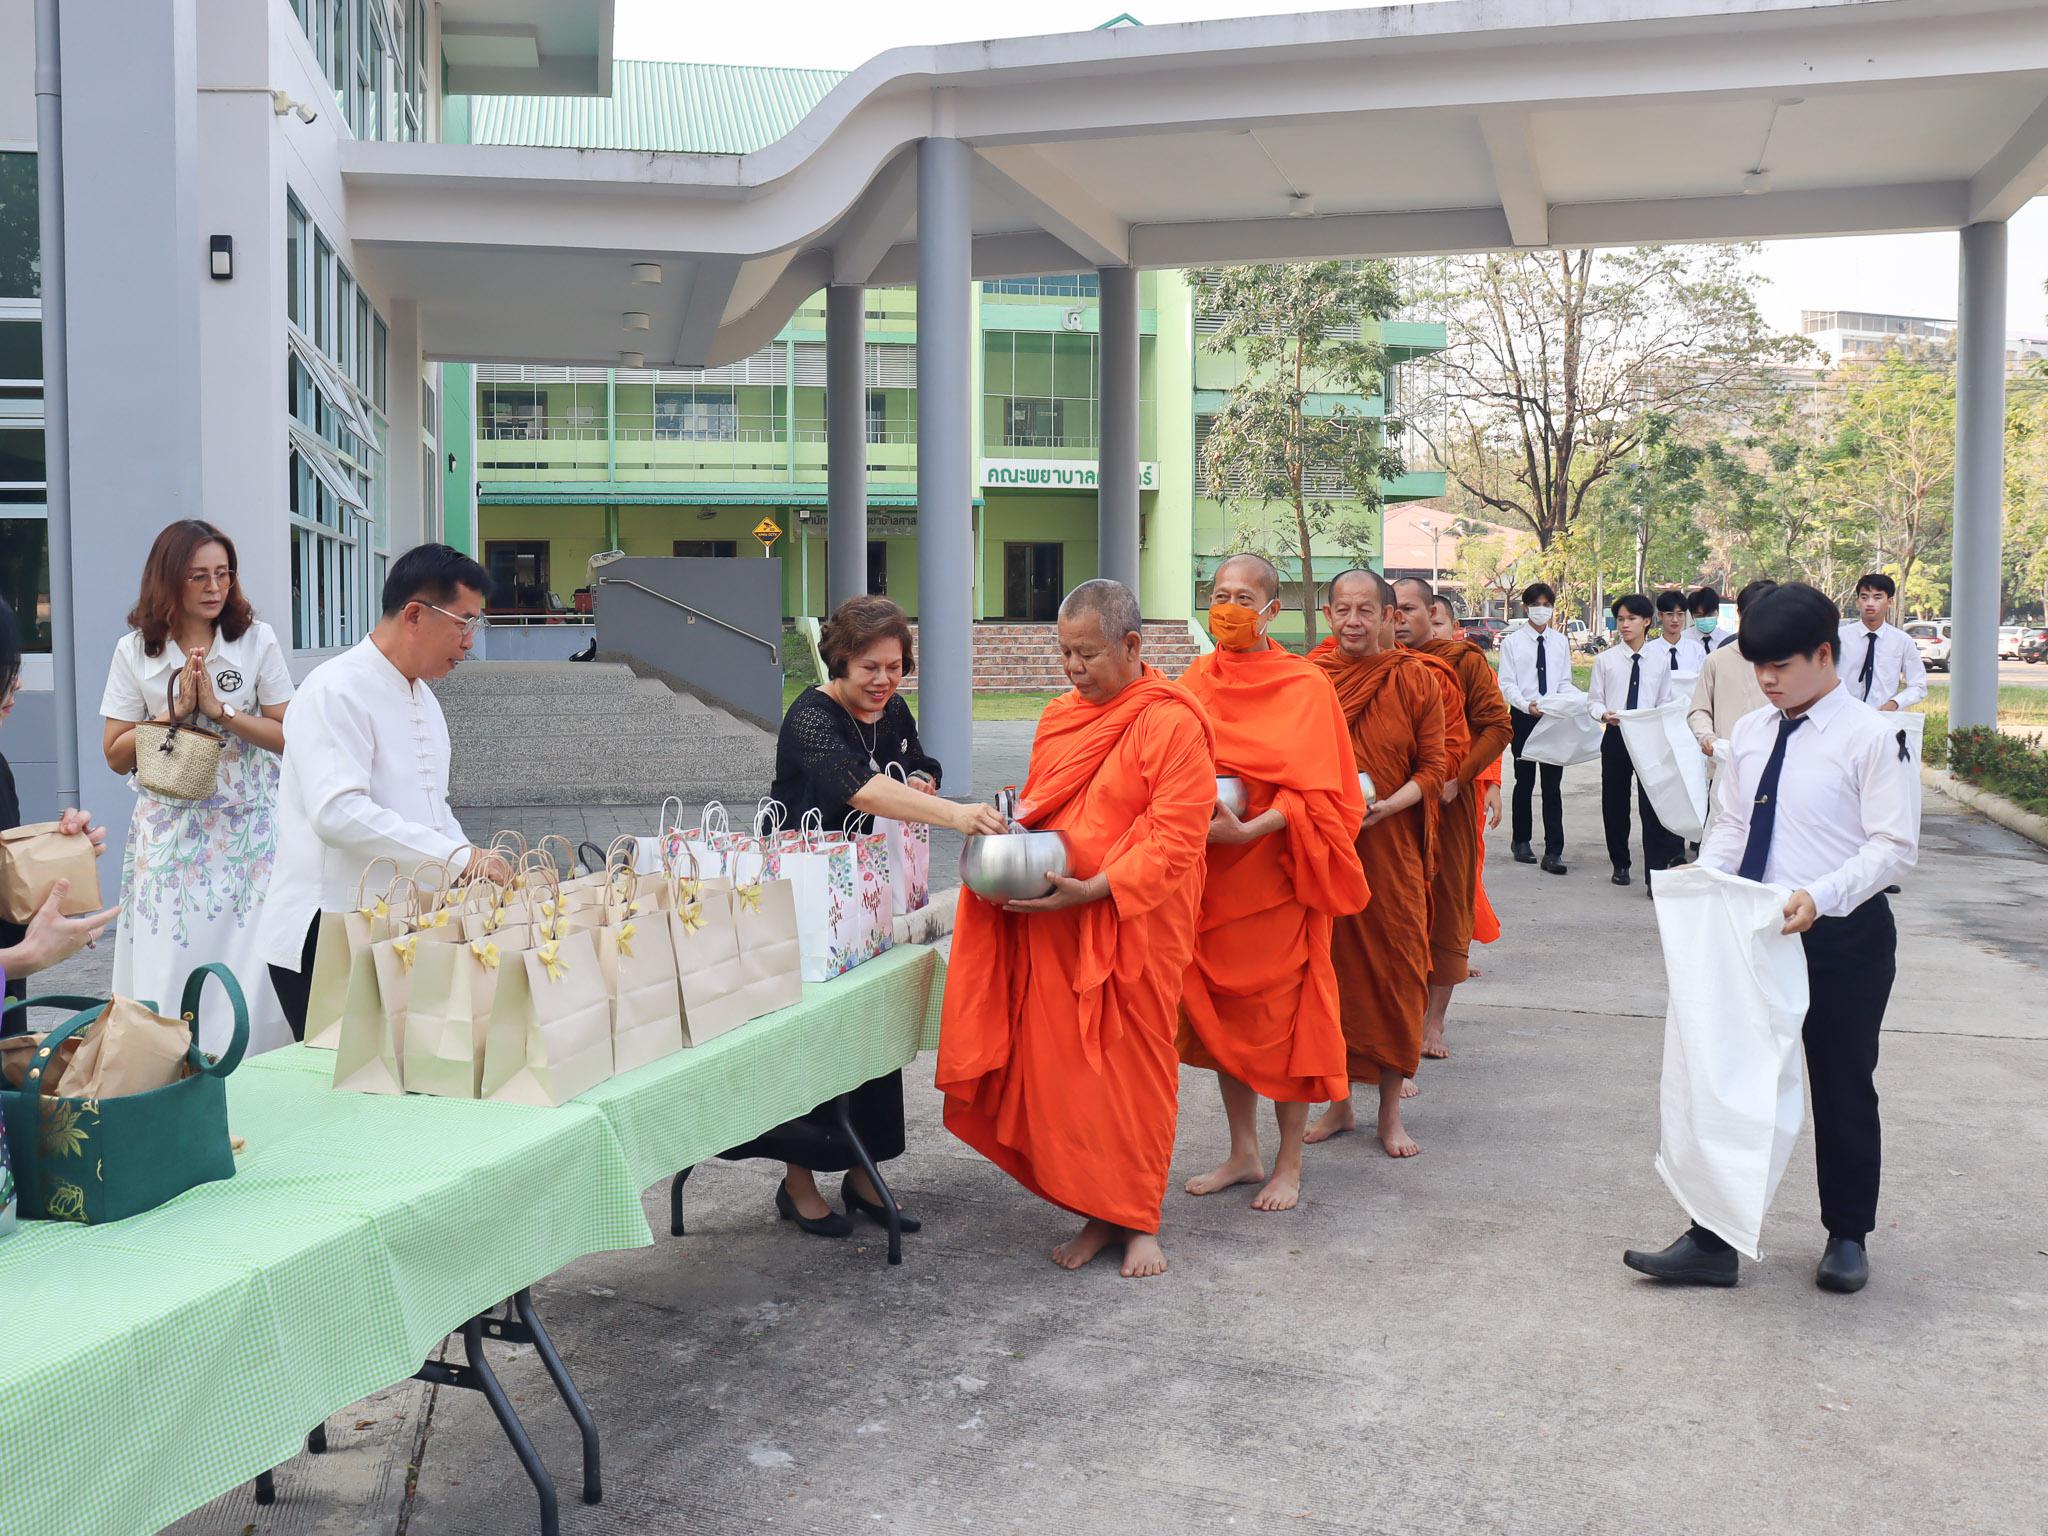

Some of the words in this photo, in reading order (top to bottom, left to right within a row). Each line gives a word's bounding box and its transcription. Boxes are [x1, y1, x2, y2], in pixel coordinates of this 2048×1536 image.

[988, 465, 1153, 486] คณะพยาบาลร์
